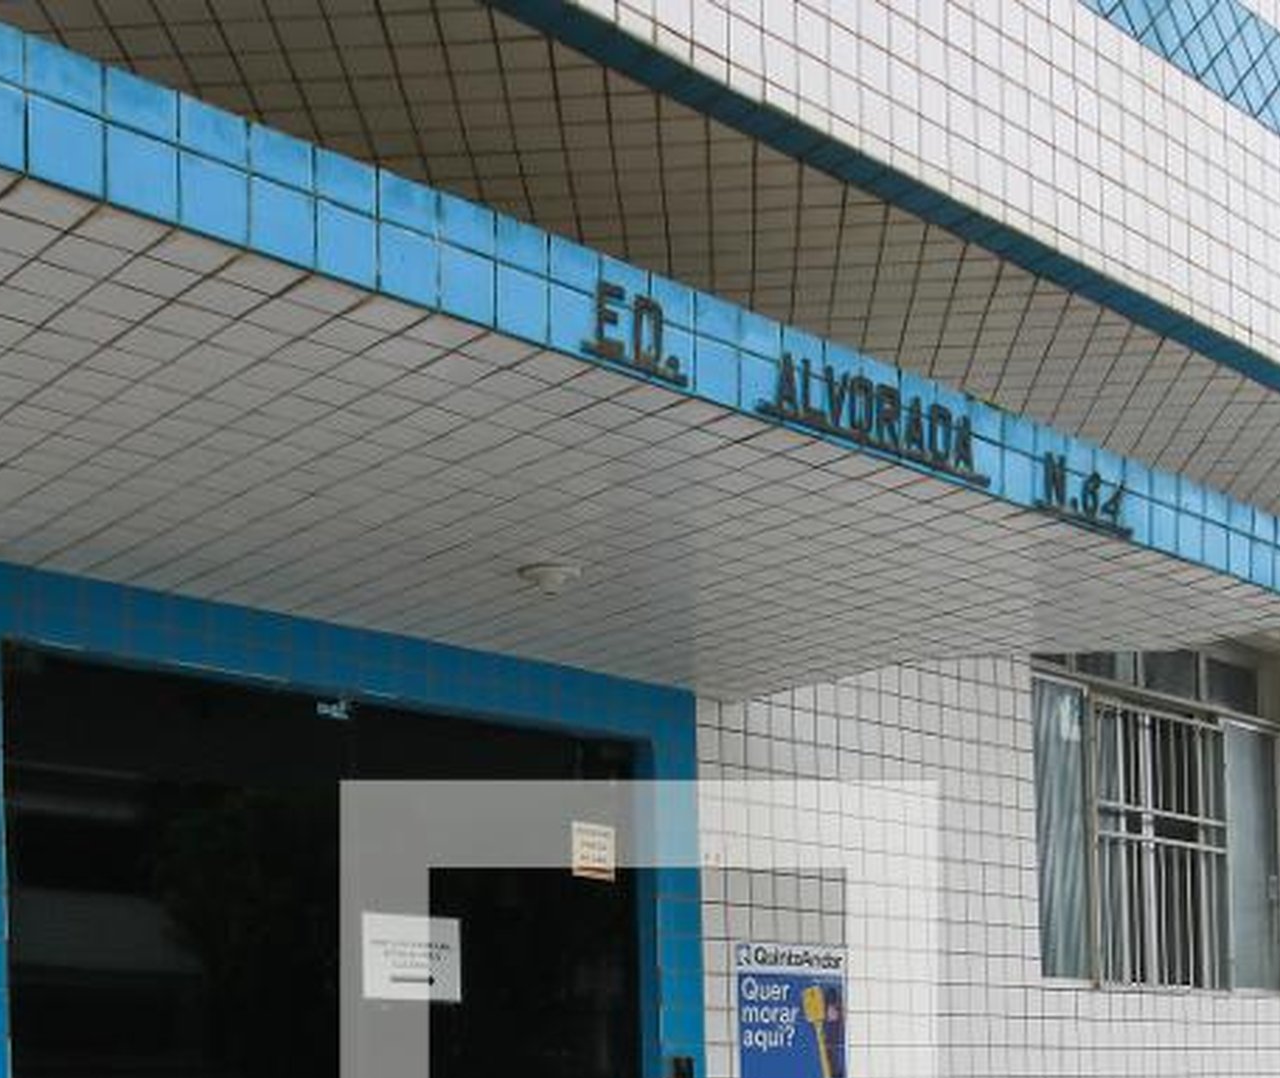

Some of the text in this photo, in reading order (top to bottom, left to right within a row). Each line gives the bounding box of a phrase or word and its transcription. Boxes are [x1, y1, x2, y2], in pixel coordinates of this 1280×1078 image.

[593, 281, 682, 381] ED.
[775, 352, 976, 476] ALVORADA
[741, 977, 790, 1002] Quer
[742, 1006, 799, 1023] morar
[743, 1025, 795, 1052] aqui?
